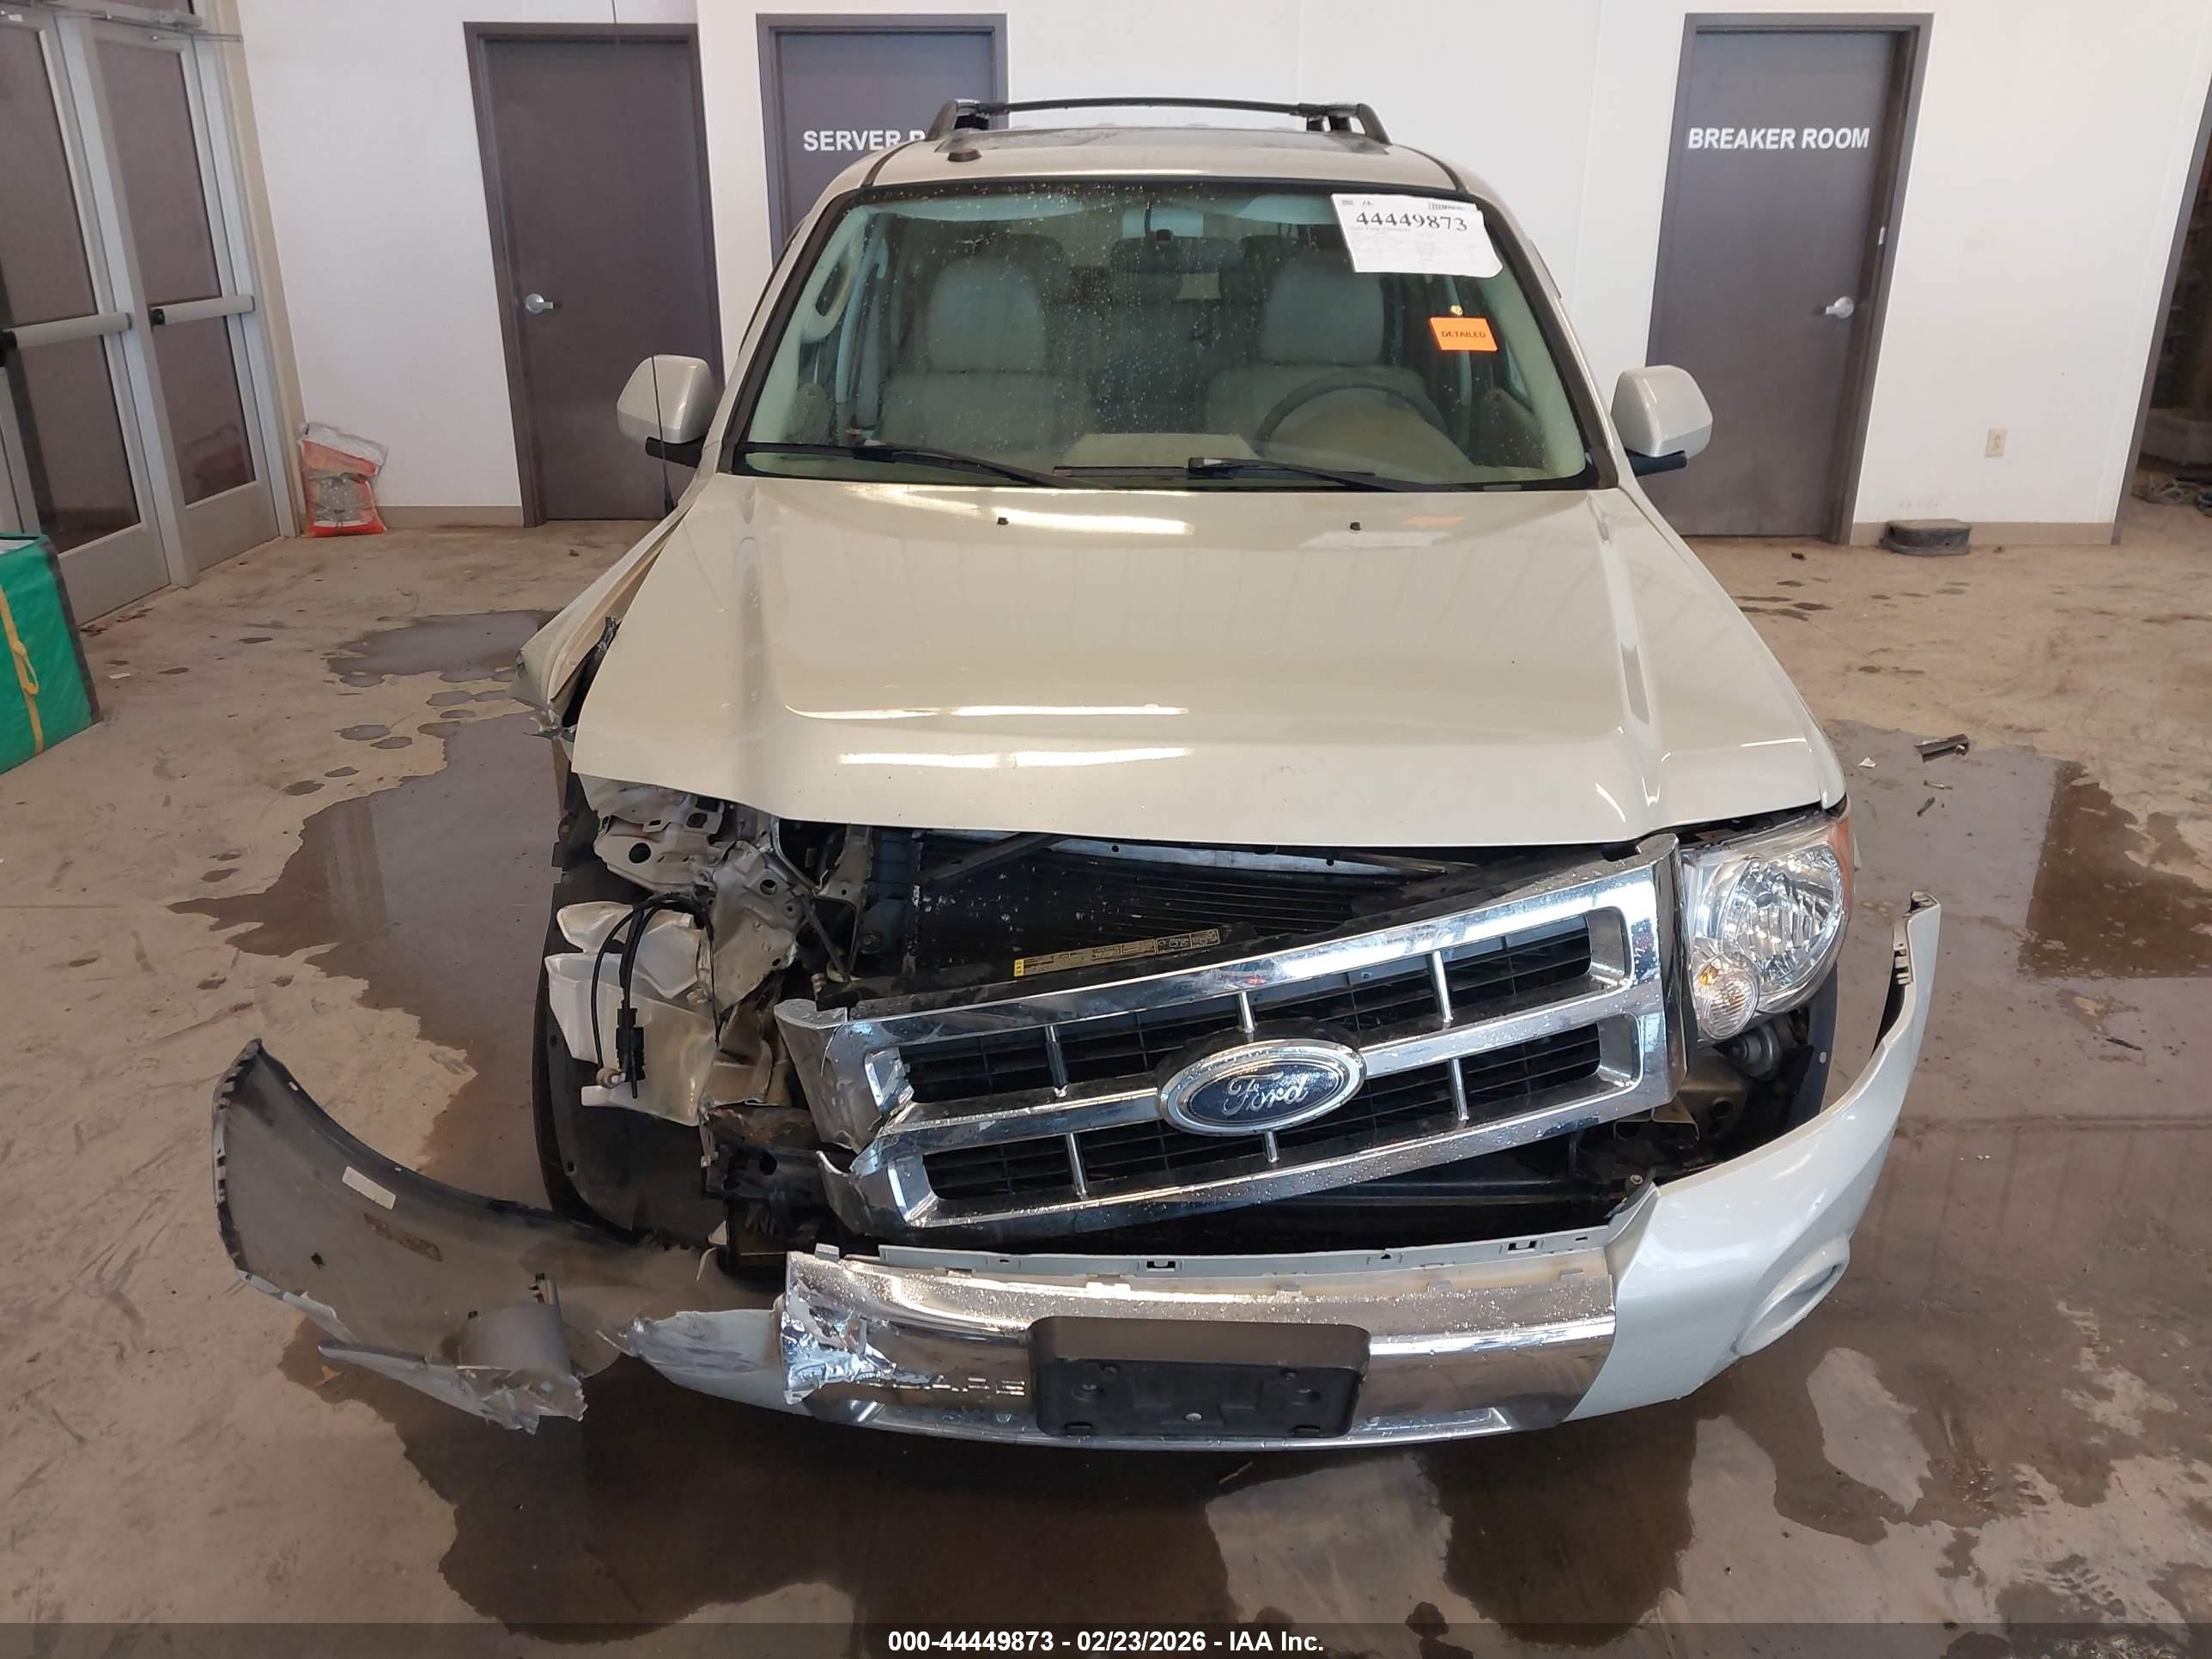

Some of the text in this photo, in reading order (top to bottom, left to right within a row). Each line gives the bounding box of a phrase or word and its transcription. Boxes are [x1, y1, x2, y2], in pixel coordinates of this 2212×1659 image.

[804, 130, 901, 151] SERVER
[1688, 128, 1870, 149] BREAKER ROOM
[1356, 211, 1468, 232] 44449873
[1441, 330, 1486, 338] DETAILED
[1223, 1071, 1309, 1115] Ford
